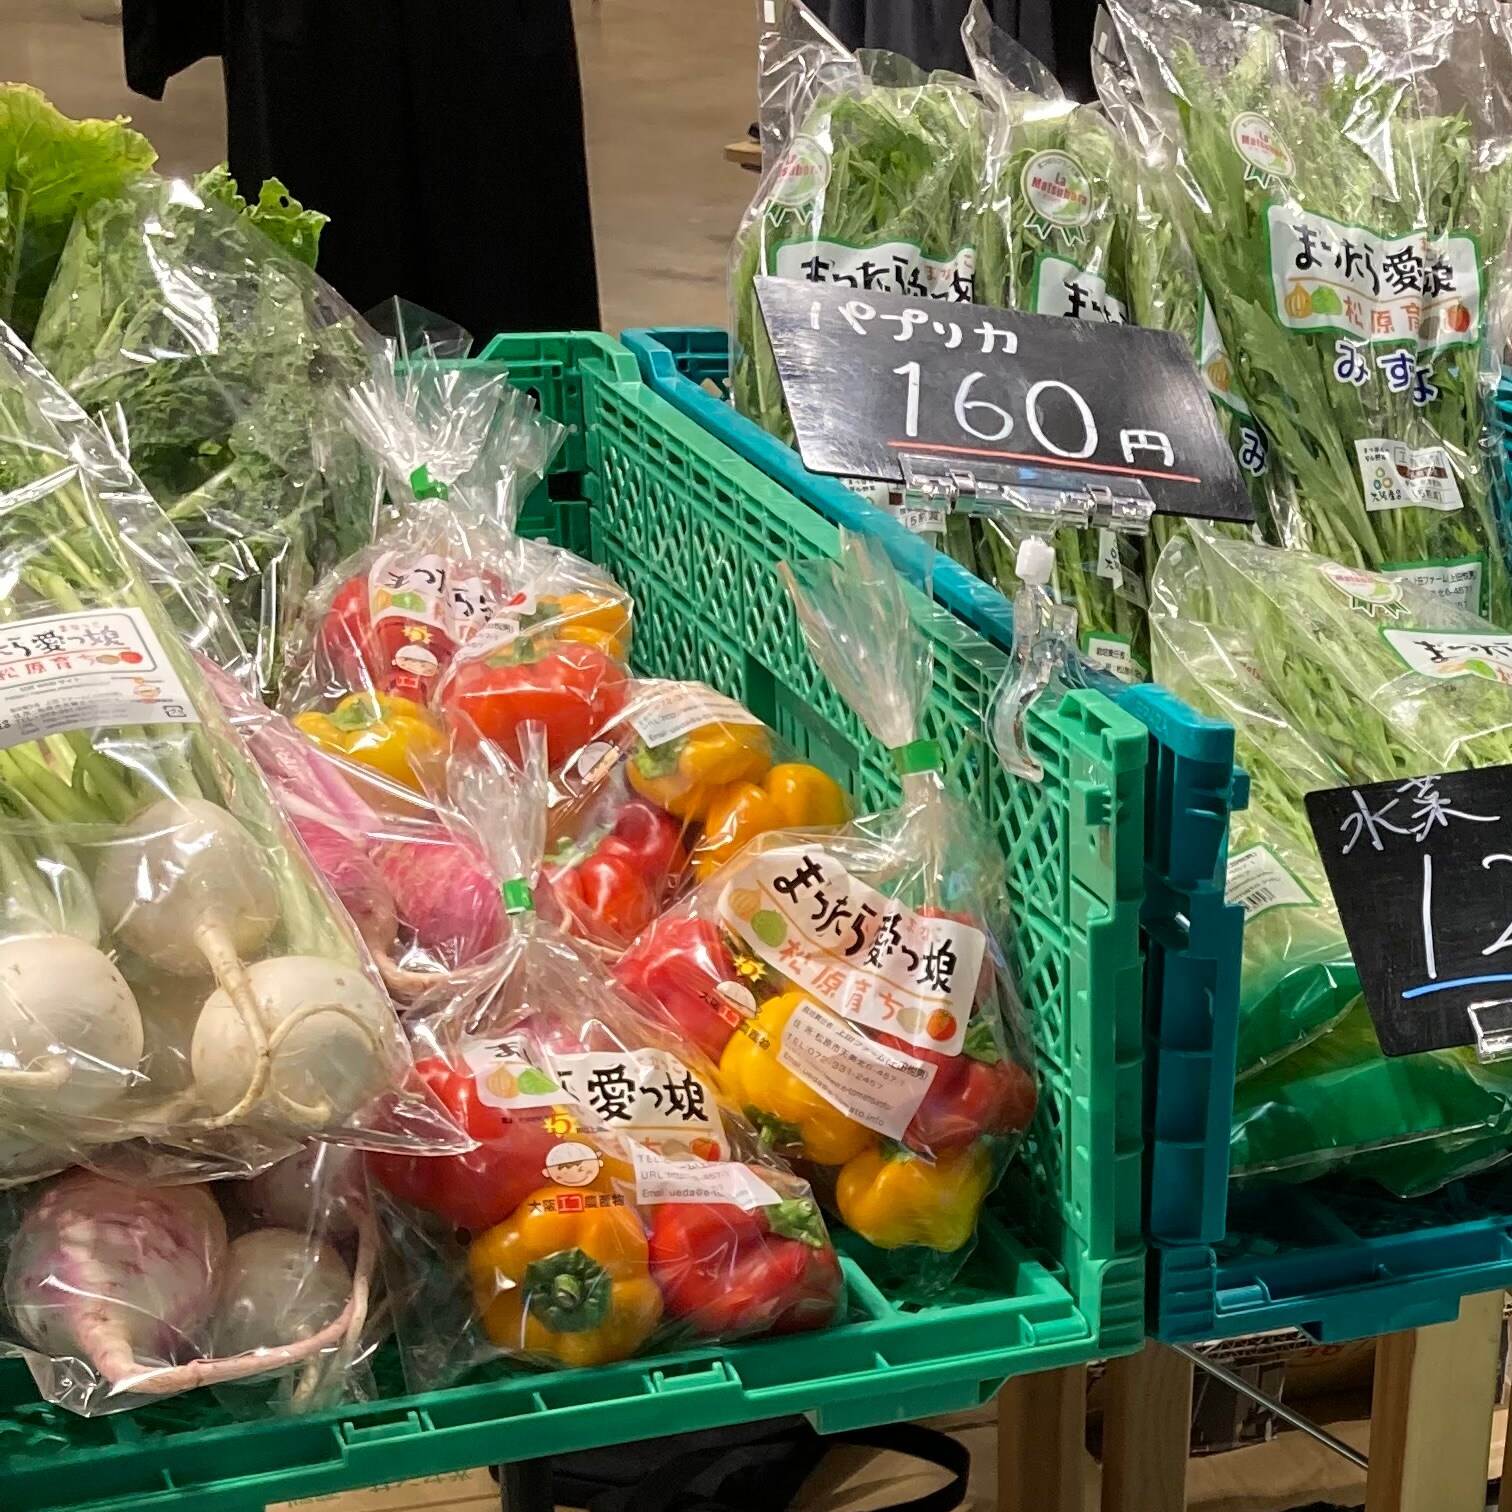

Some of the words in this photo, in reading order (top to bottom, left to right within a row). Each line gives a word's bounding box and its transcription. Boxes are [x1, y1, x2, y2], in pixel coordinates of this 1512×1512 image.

[810, 300, 1019, 357] パプリカ
[893, 360, 1176, 468] 160円
[1341, 774, 1501, 854] 水菜
